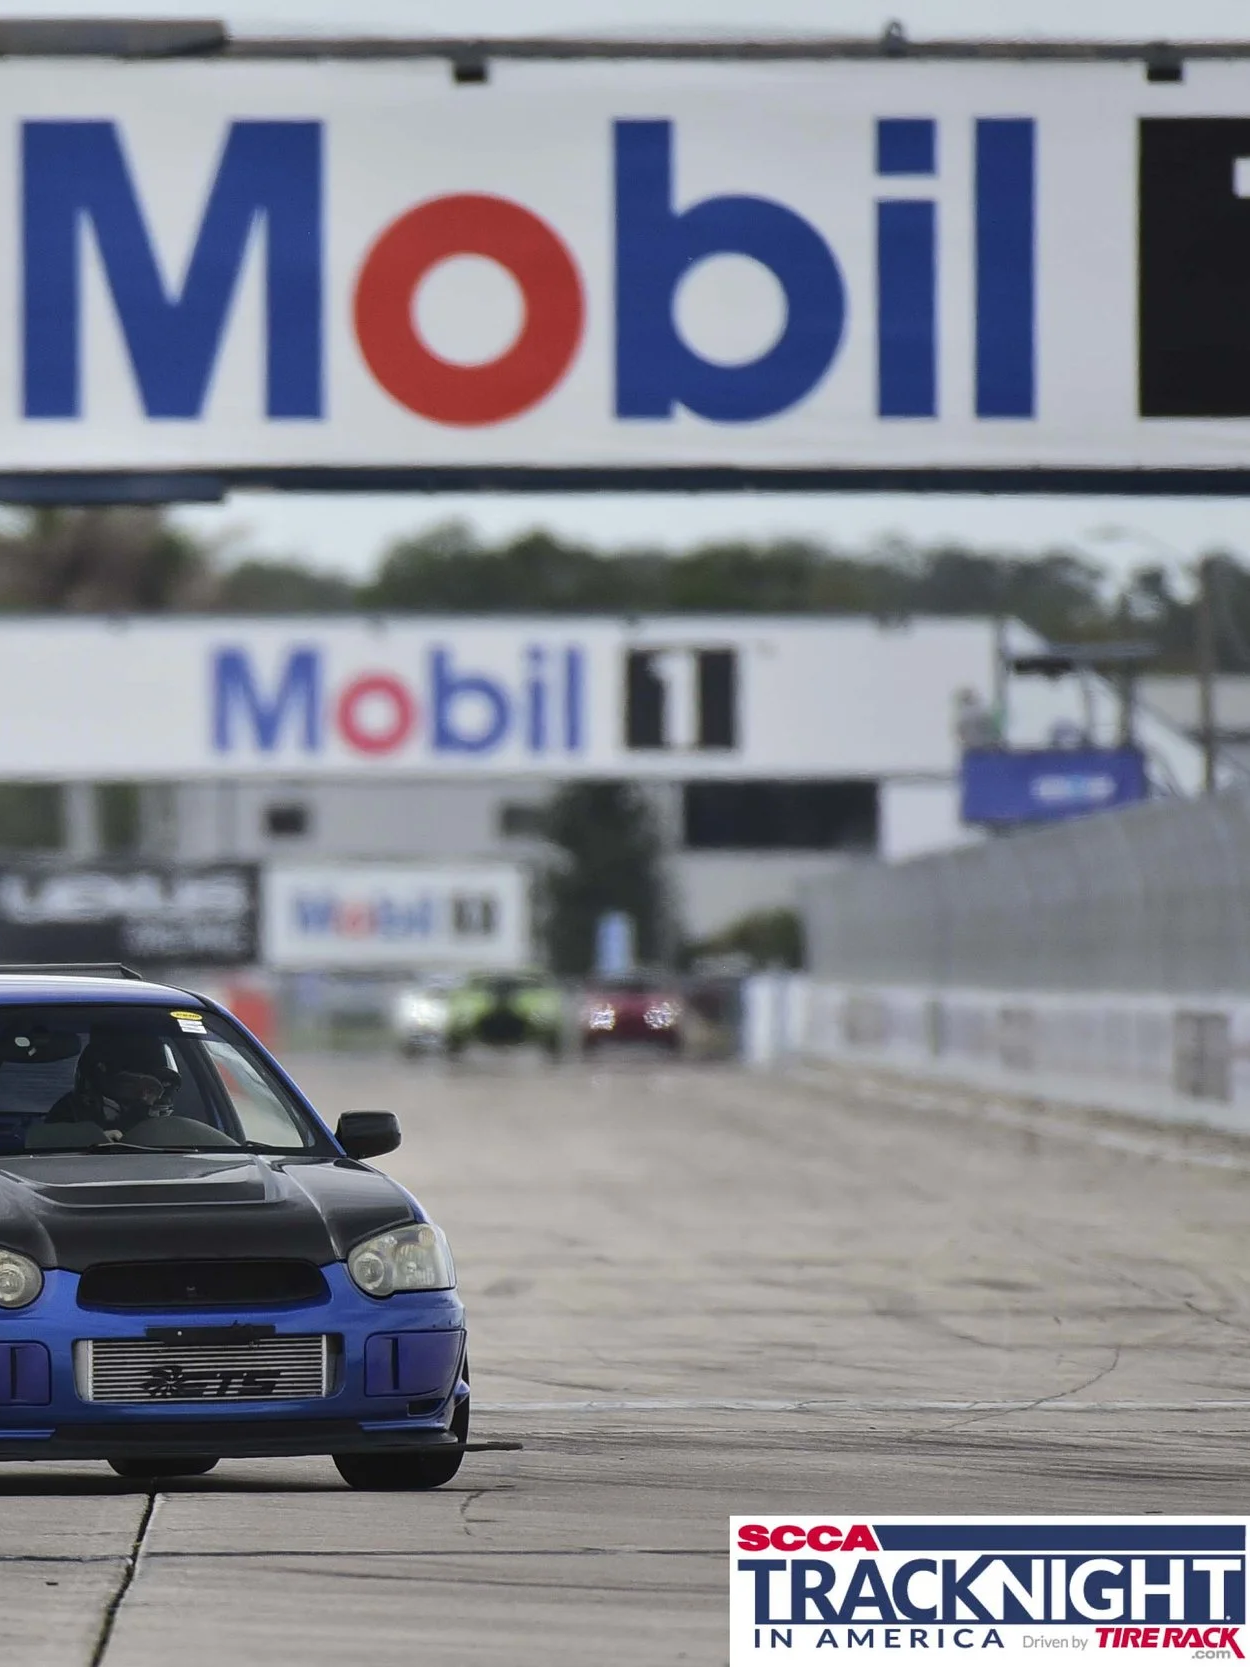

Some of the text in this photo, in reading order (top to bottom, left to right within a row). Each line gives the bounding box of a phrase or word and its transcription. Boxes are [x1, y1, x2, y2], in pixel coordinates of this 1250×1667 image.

[19, 117, 1037, 427] Mobil
[213, 646, 705, 757] Mobil 1
